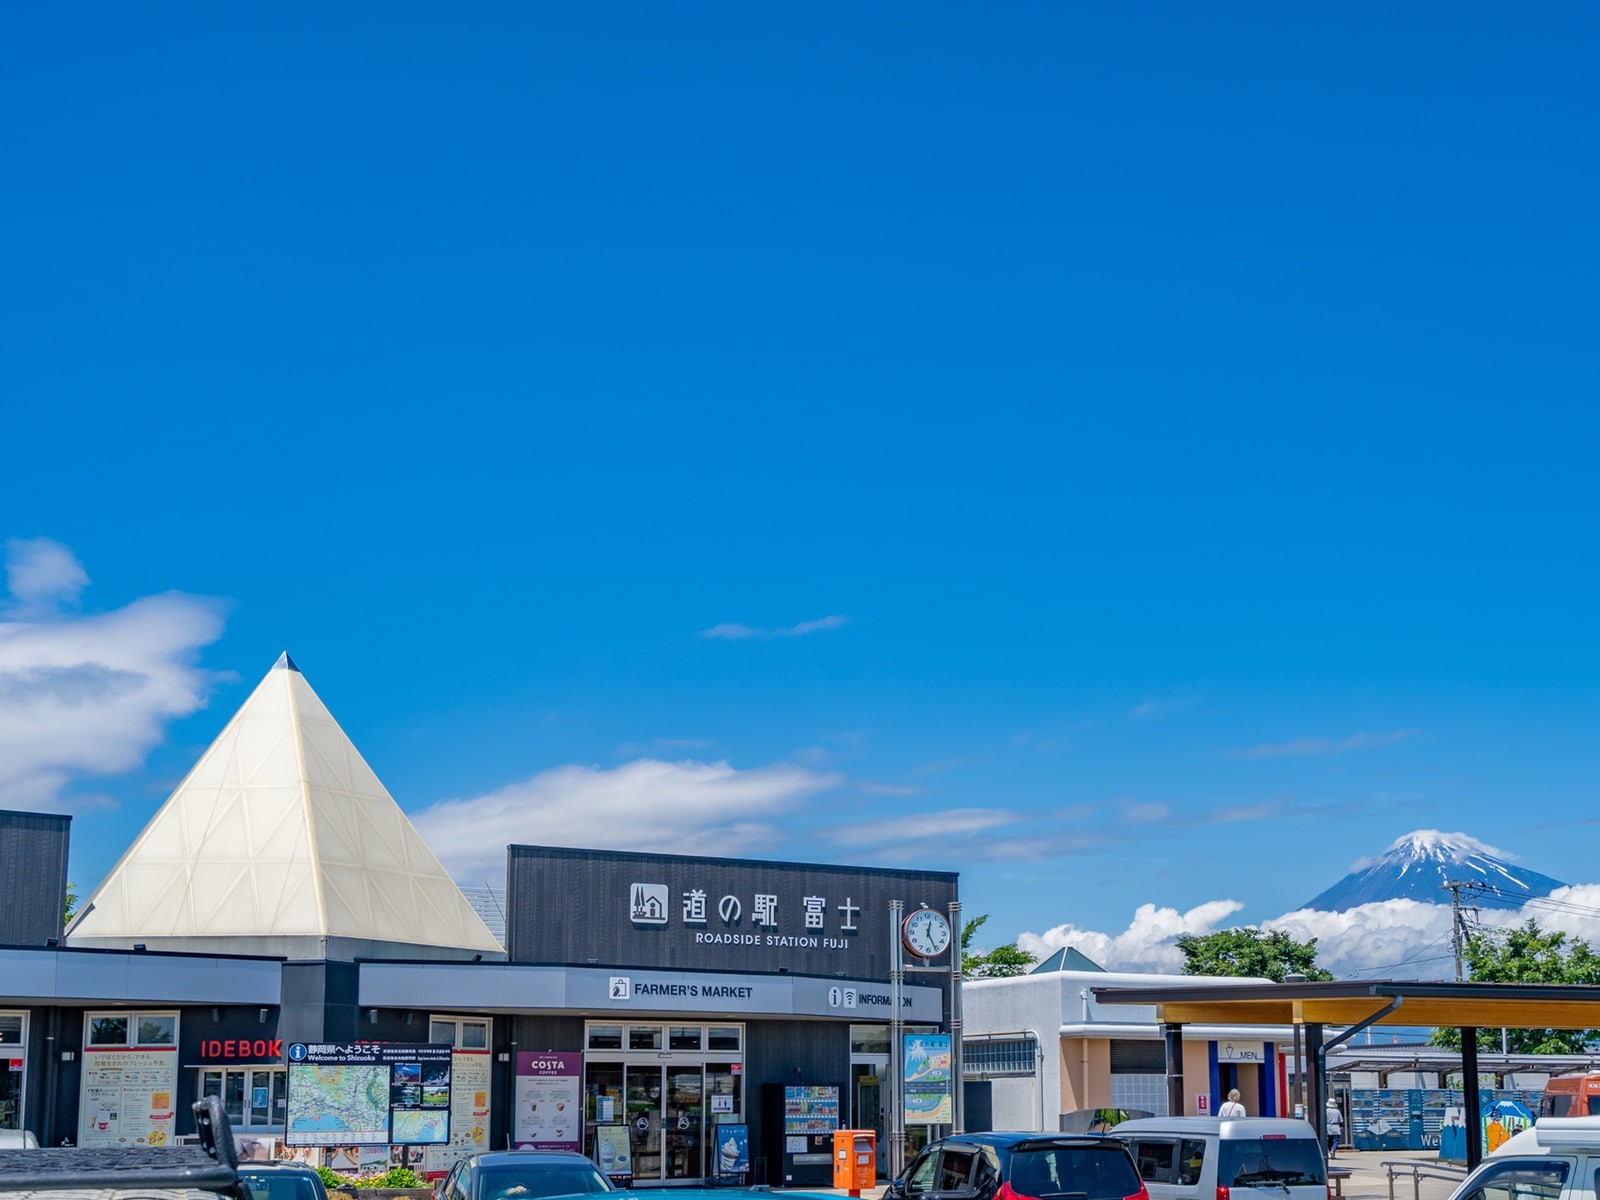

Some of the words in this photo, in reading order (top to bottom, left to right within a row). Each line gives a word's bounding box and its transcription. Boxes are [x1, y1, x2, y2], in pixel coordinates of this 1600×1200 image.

[683, 889, 778, 926] 道の駅
[803, 896, 860, 930] 富士
[696, 932, 761, 945] ROADSIDE
[766, 935, 818, 948] STATION
[823, 938, 849, 949] FUJI
[634, 984, 698, 997] FARMER'S
[702, 986, 753, 998] MARKET
[201, 1039, 283, 1058] IDEBOK
[308, 1044, 381, 1055] 静岡県へようこそ
[1240, 1051, 1258, 1060] MEN
[531, 1060, 565, 1070] COSTA
